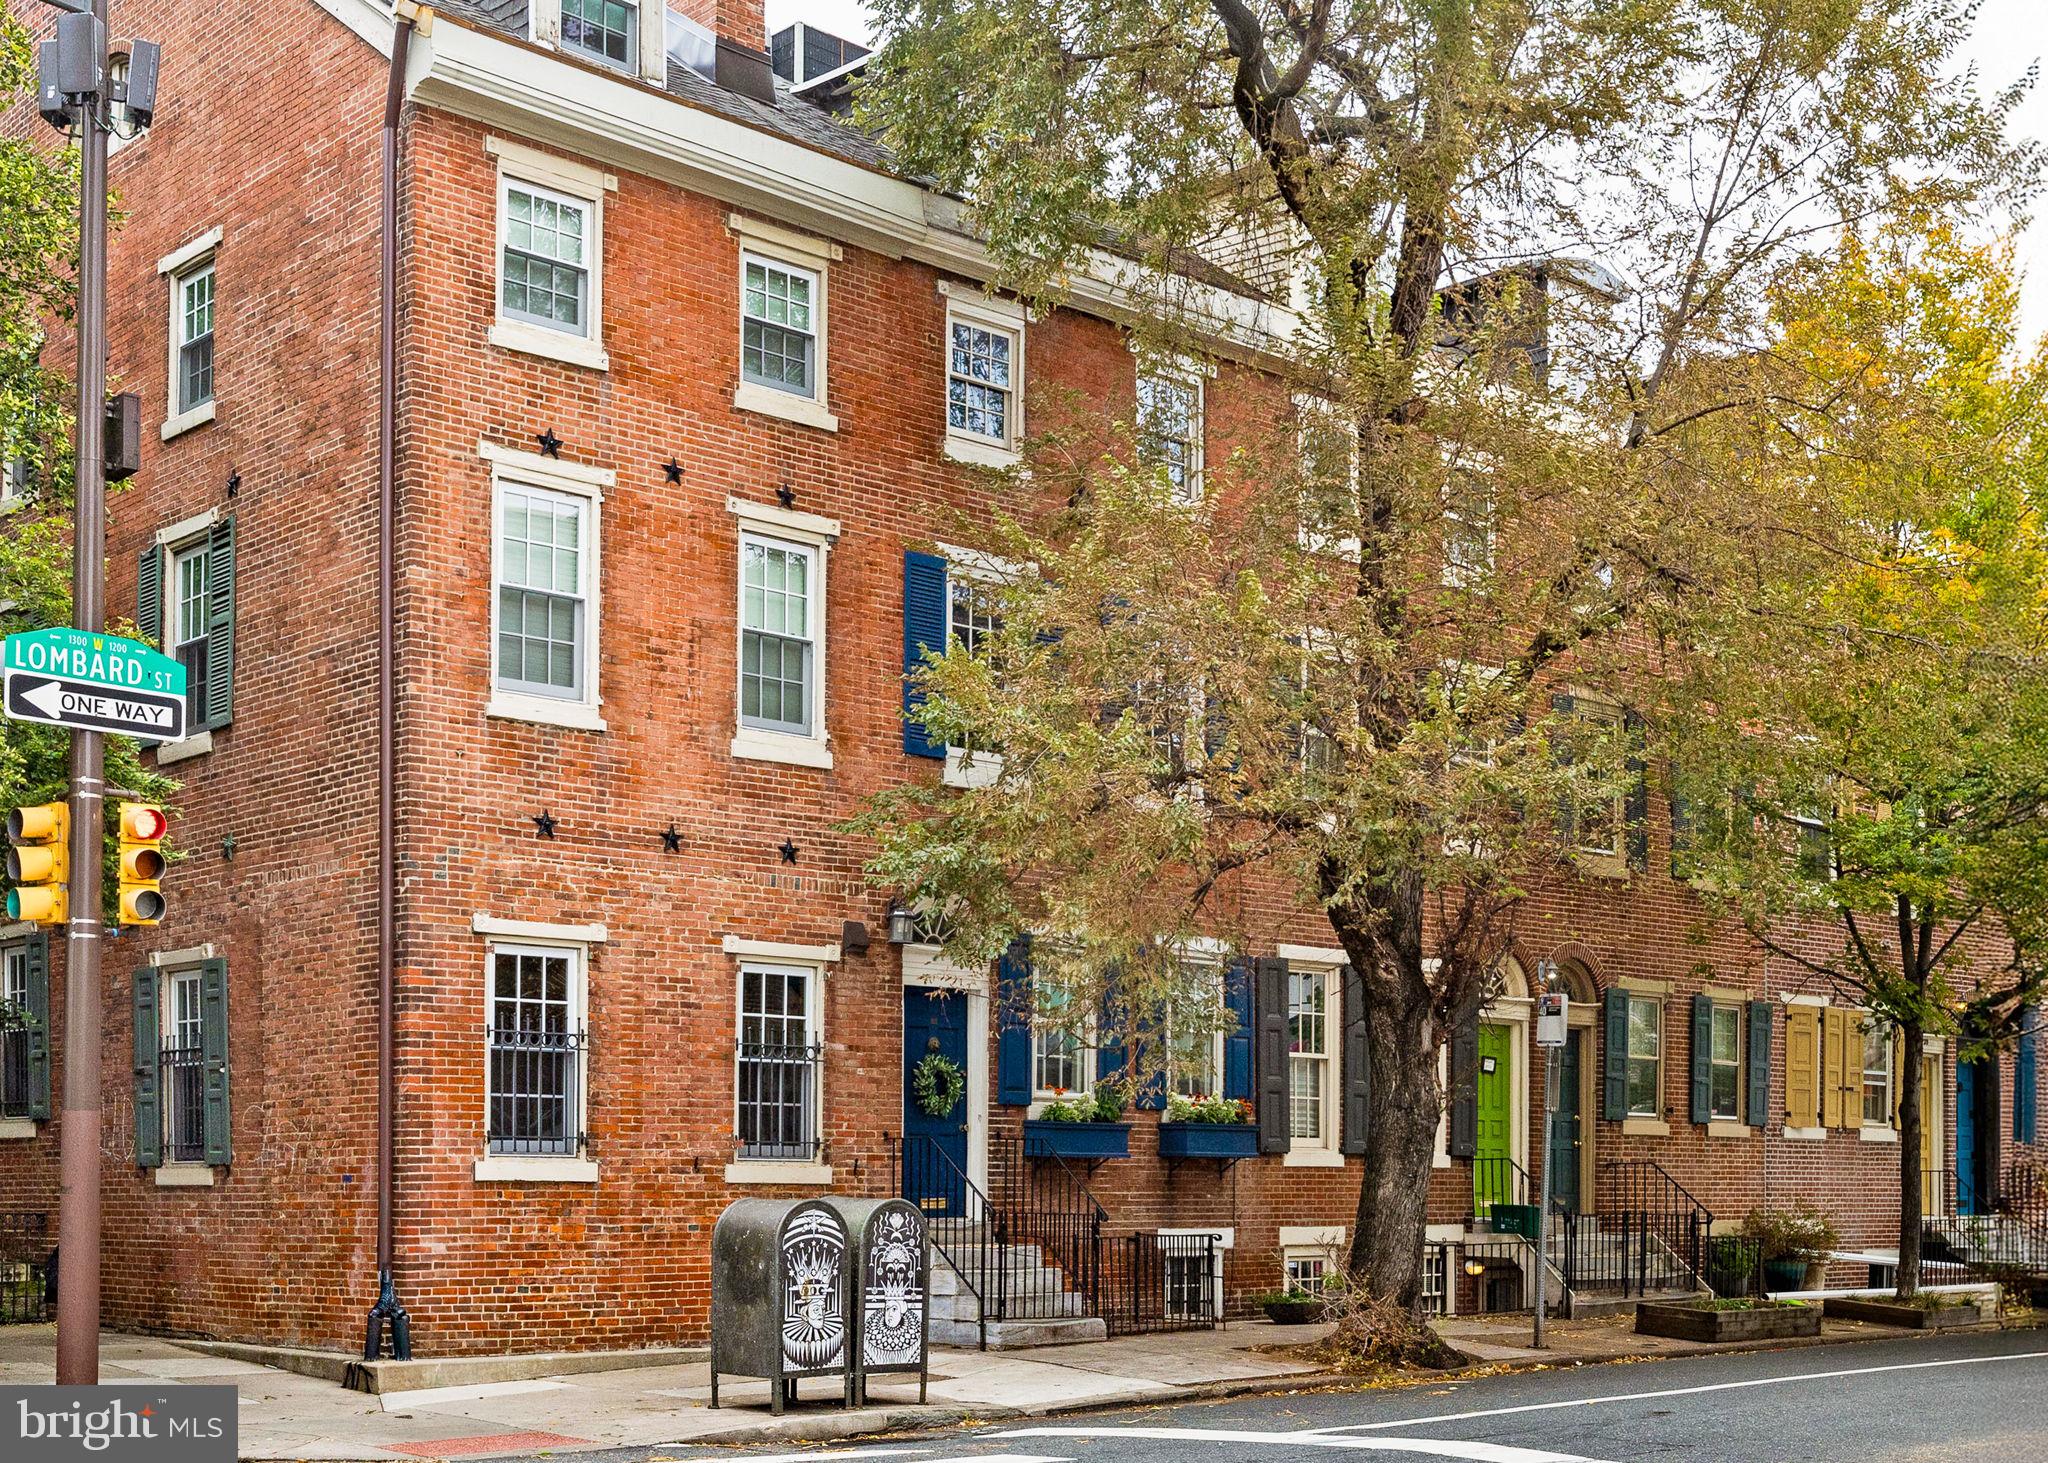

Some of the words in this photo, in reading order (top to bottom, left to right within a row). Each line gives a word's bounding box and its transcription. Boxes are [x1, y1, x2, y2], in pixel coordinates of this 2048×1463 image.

[68, 634, 88, 647] 1300
[93, 637, 104, 651] W
[109, 642, 128, 653] 1200
[15, 639, 144, 685] LOMBARD
[154, 671, 173, 691] ST
[61, 694, 107, 716] ONE
[115, 701, 164, 723] WAY
